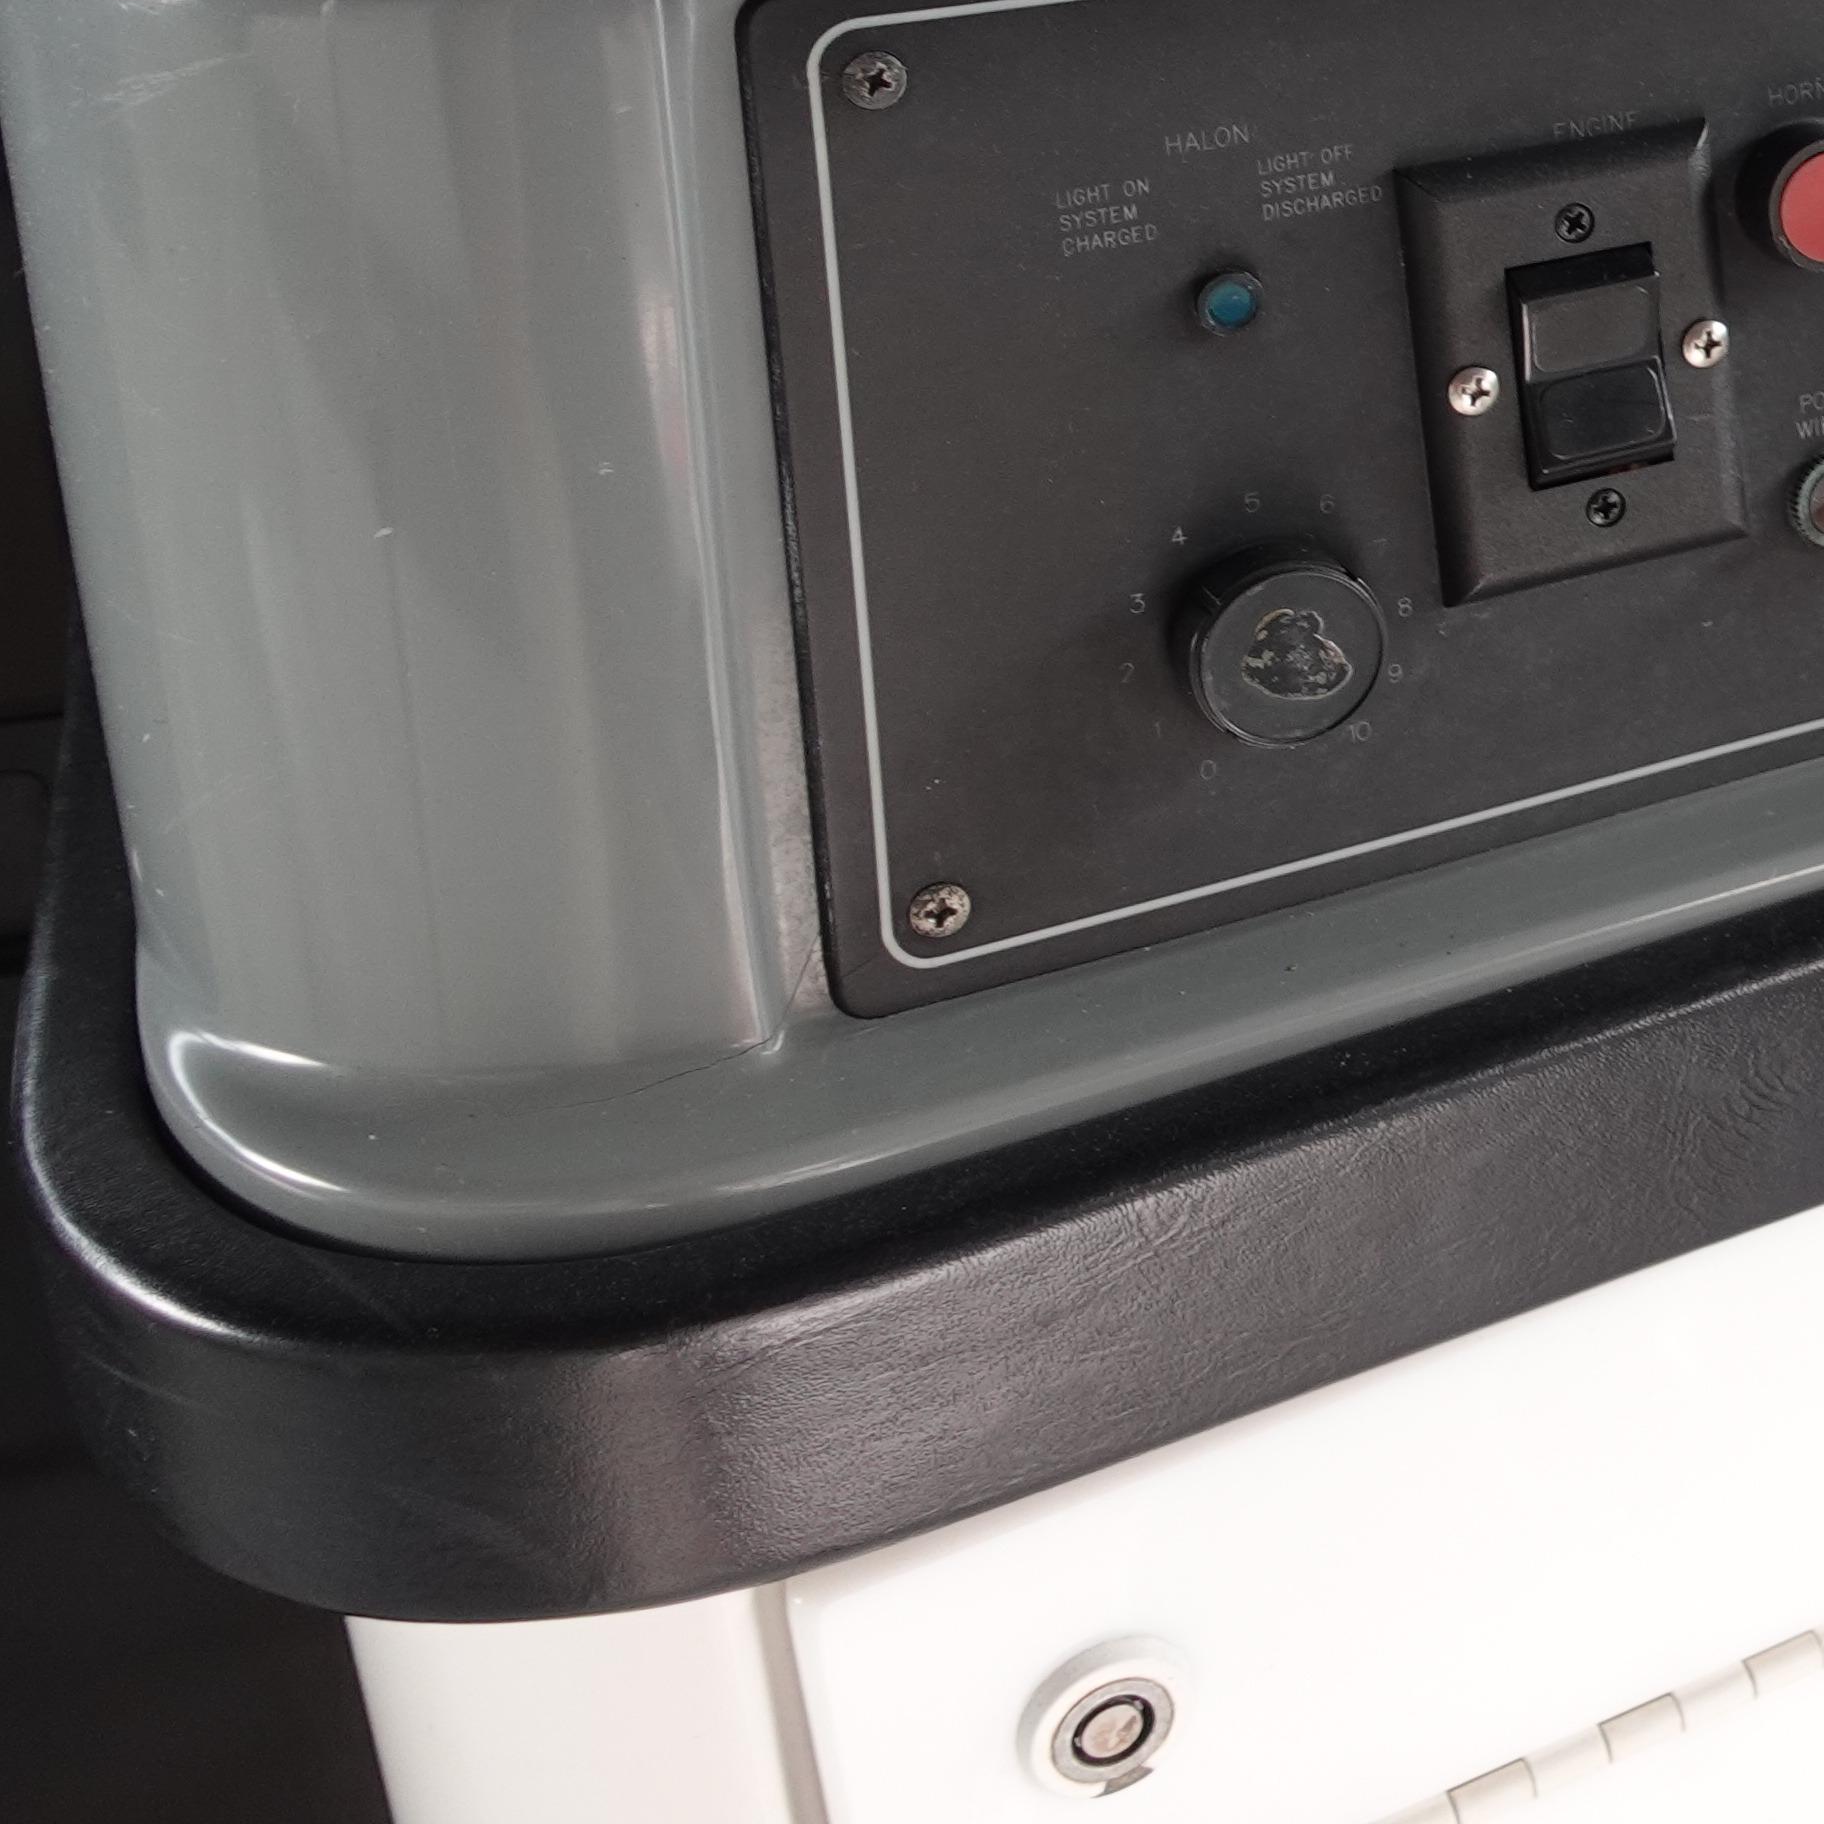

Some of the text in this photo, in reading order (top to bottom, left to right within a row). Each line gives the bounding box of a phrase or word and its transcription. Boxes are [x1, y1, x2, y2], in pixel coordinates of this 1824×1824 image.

[1164, 122, 1252, 157] HALON
[1256, 143, 1354, 176] LIGHT OFF
[1054, 178, 1152, 210] LIGHT ON
[1259, 171, 1335, 199] SYSTEM
[1262, 185, 1384, 222] DISCHARGED
[1058, 203, 1139, 232] SYSTEM
[1061, 223, 1160, 257] CHARGED
[1244, 492, 1261, 513] 5
[1319, 493, 1336, 514] 6
[1171, 525, 1188, 546] 4
[1128, 592, 1147, 615] 3
[1397, 596, 1414, 618] 8
[1387, 662, 1403, 684] 9
[1349, 720, 1373, 742] 10
